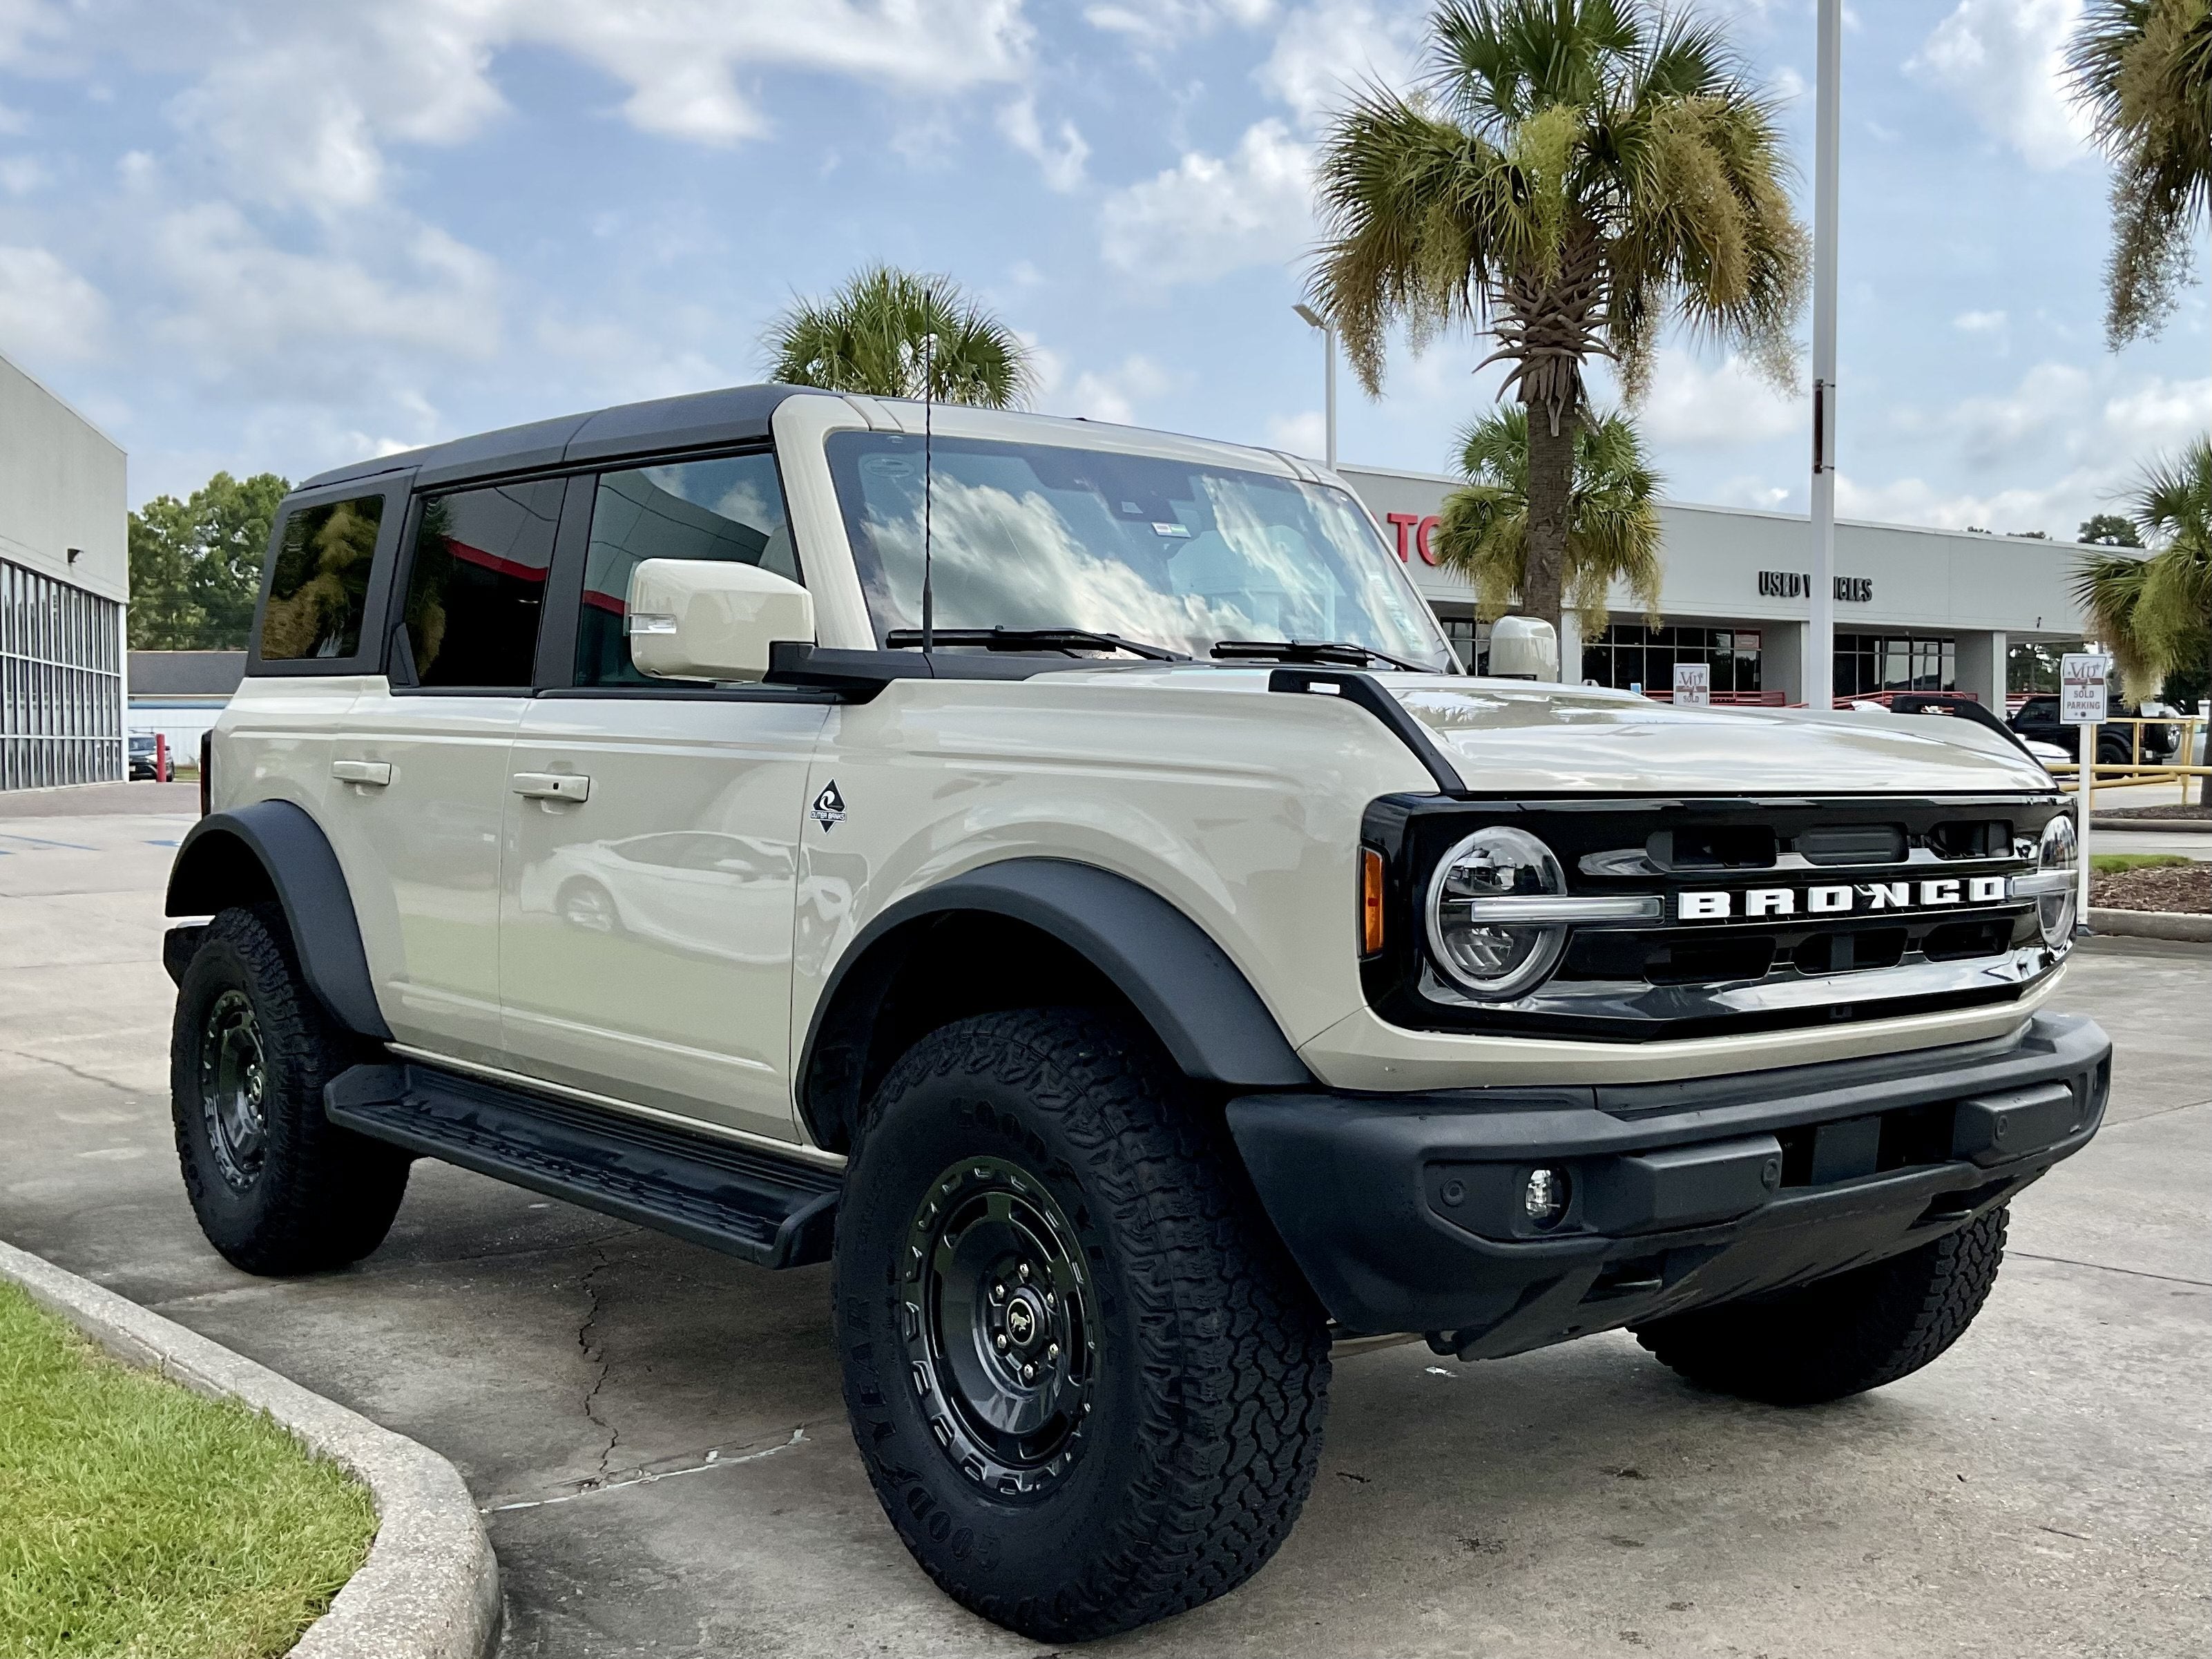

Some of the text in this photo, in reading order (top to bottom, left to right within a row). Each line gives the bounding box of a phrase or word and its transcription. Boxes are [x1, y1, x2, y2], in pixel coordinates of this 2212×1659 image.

[1370, 510, 1443, 566] TO
[1758, 570, 1801, 597] USED
[1683, 695, 1700, 703] SOLD
[2074, 690, 2095, 698] SOLD
[2066, 701, 2101, 709] PARKING
[1678, 876, 2006, 920] BRONCO
